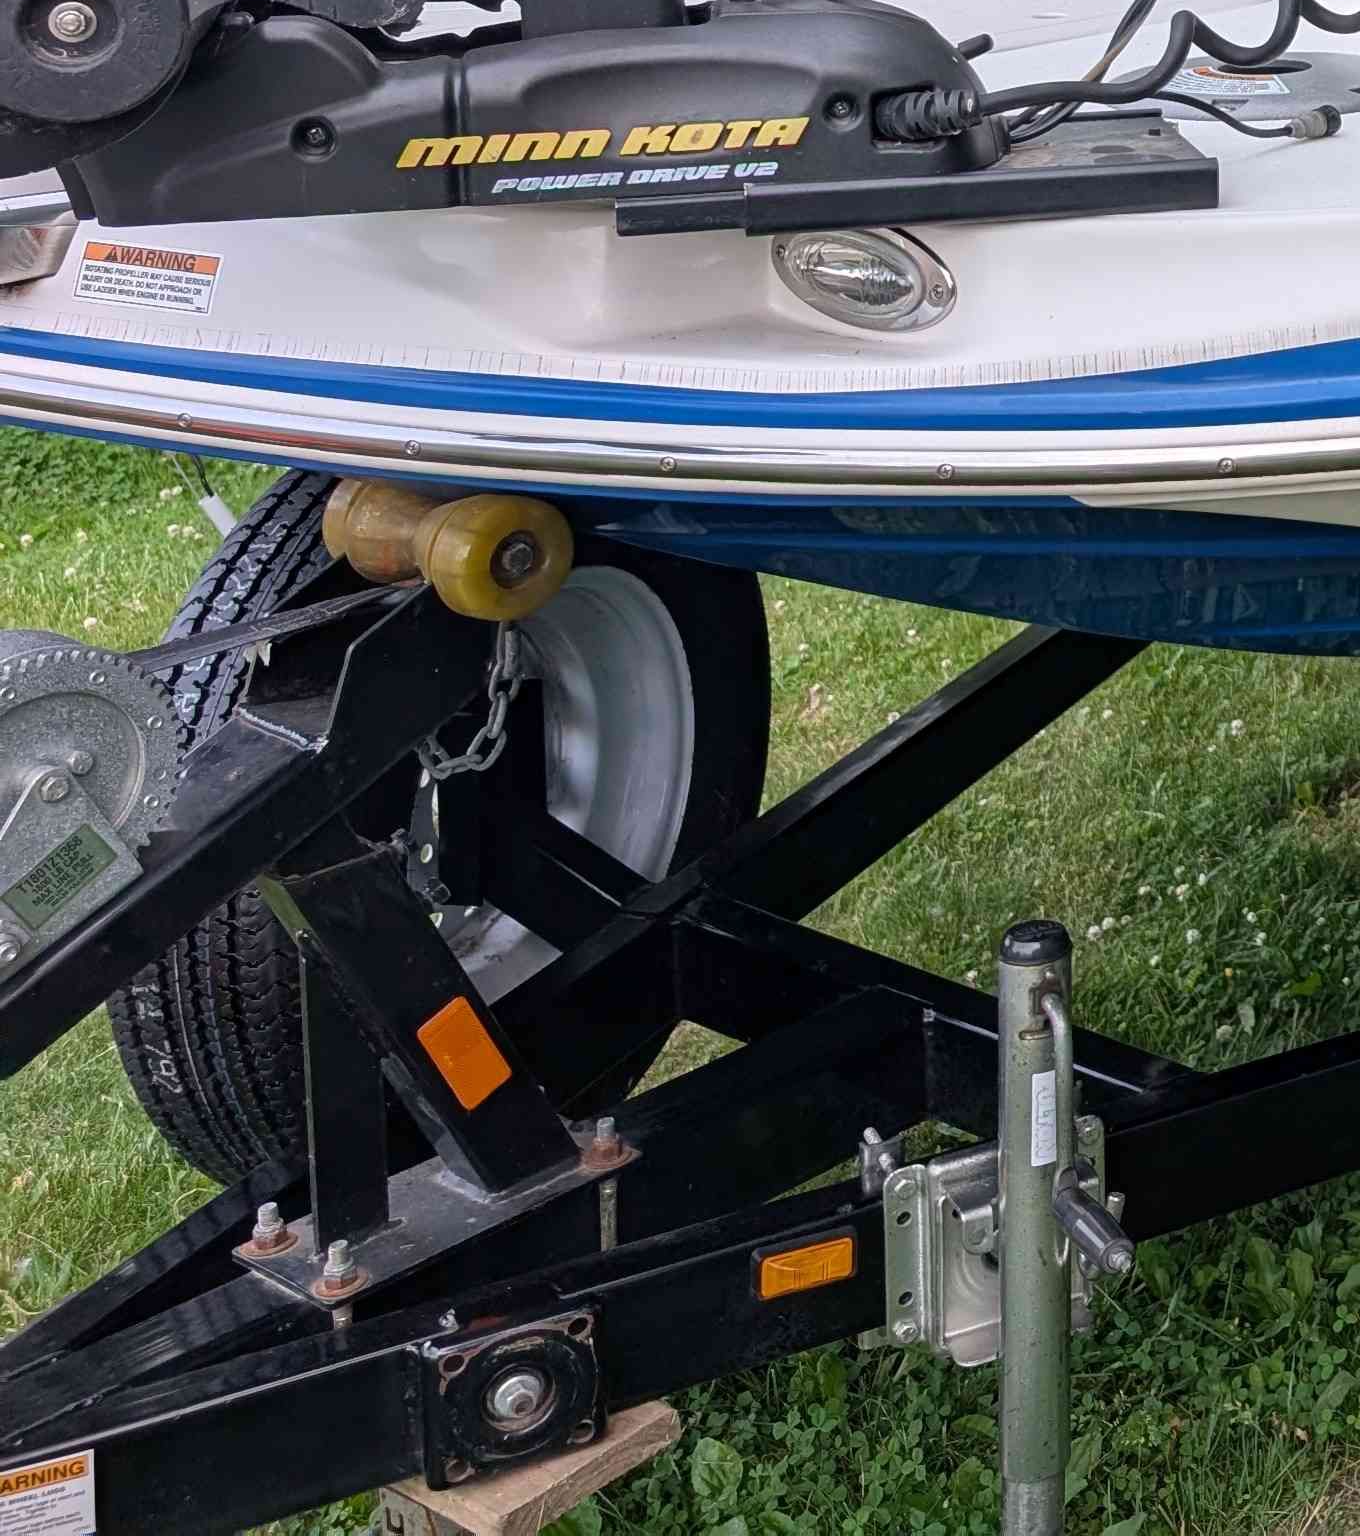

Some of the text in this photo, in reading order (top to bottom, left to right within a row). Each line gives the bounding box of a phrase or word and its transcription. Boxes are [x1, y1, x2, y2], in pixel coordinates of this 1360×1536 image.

[396, 116, 811, 169] MINN KOTA
[491, 161, 780, 195] POWER DRIVE V2
[119, 247, 198, 272] WARNING
